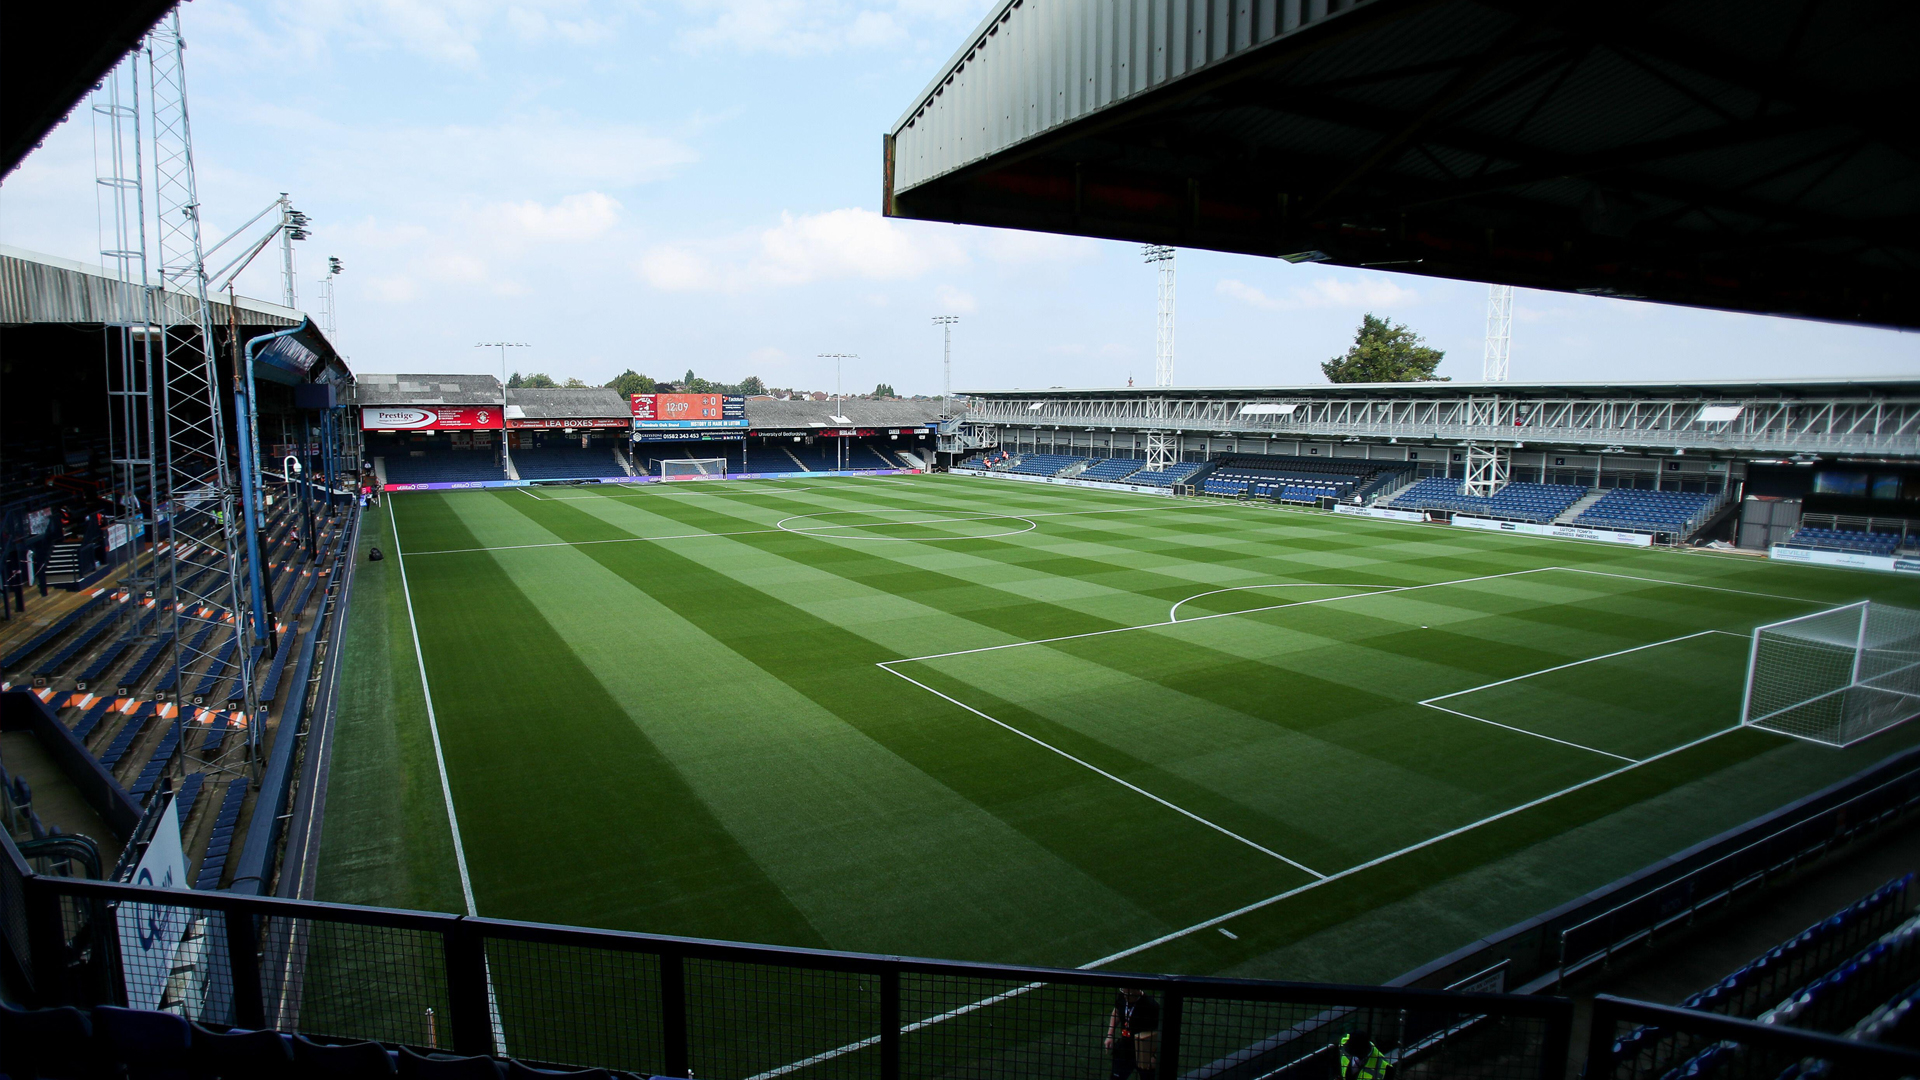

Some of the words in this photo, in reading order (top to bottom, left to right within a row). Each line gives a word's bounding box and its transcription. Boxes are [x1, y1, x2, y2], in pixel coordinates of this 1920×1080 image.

[710, 396, 716, 405] 0
[666, 402, 689, 412] 12:09
[710, 408, 716, 417] 0
